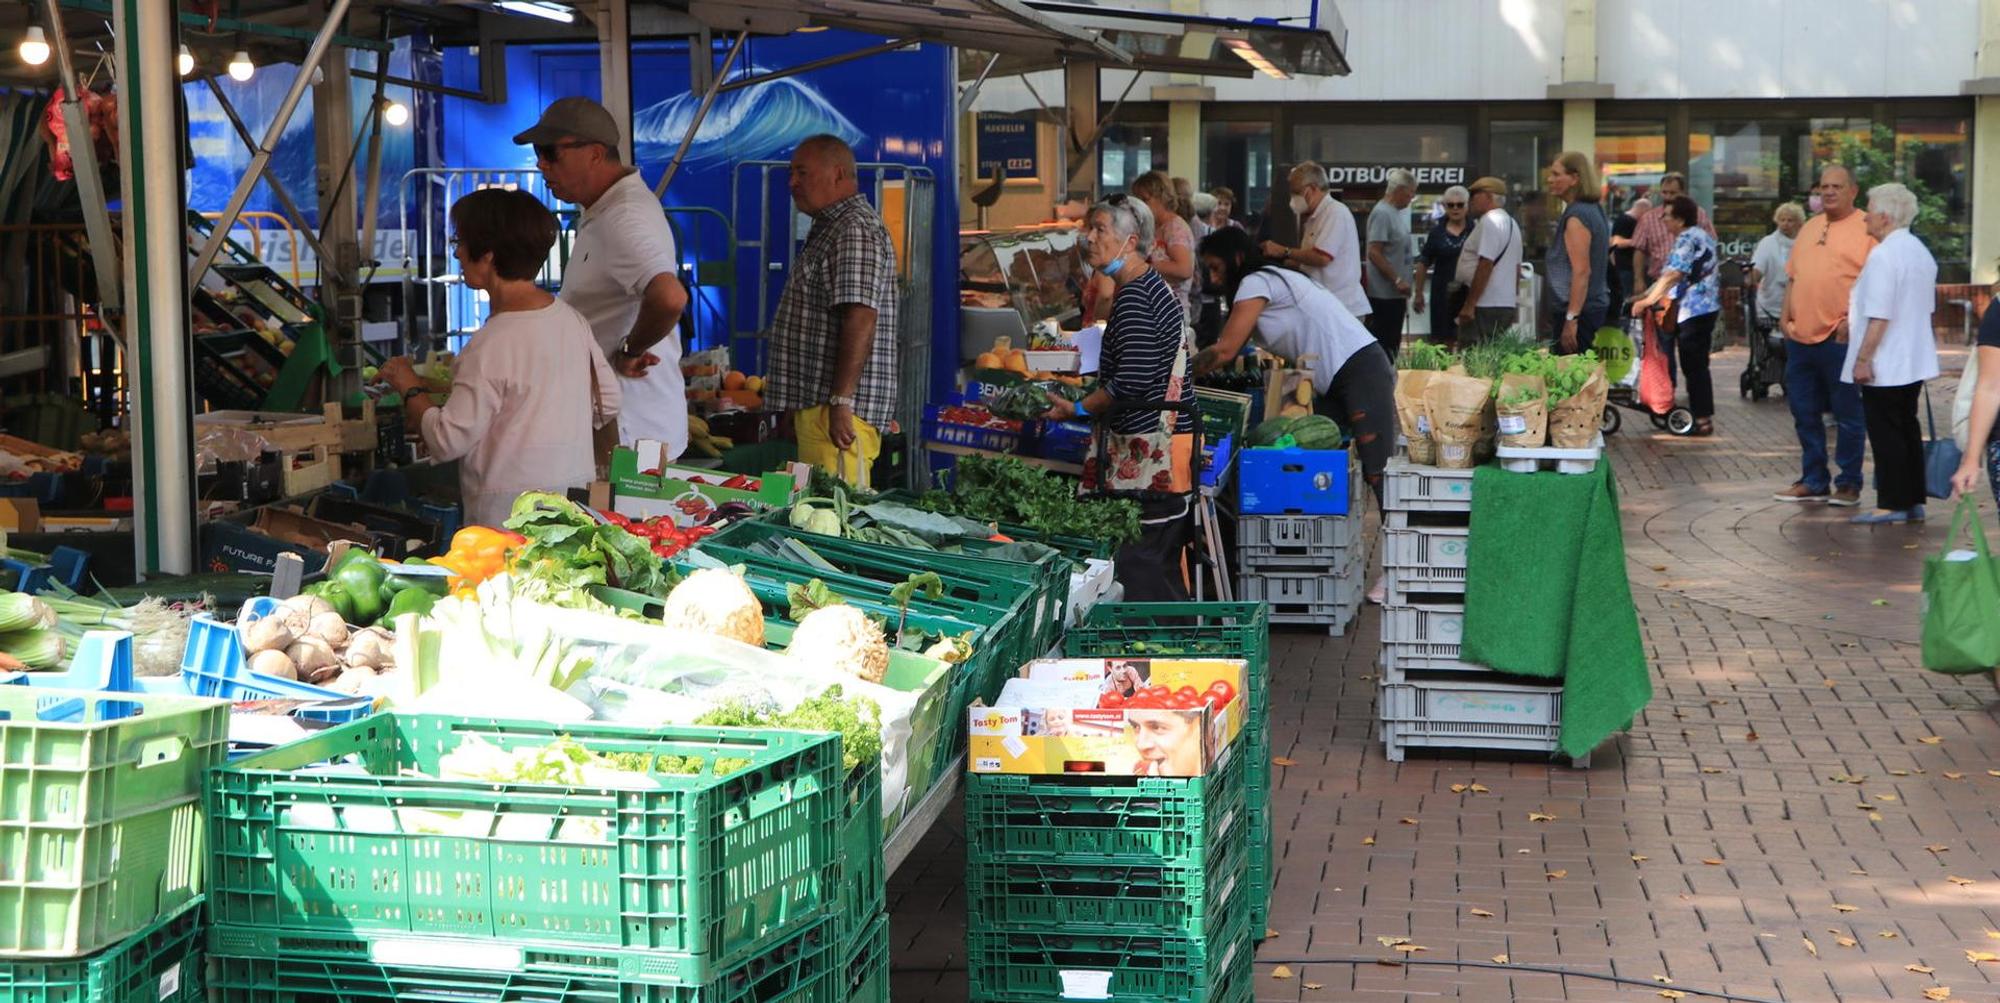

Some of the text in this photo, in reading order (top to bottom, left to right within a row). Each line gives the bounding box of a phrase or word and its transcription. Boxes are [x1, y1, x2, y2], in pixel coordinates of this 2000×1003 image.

[222, 544, 264, 565] FUTURE
[973, 715, 1018, 729] Tasty Tom
